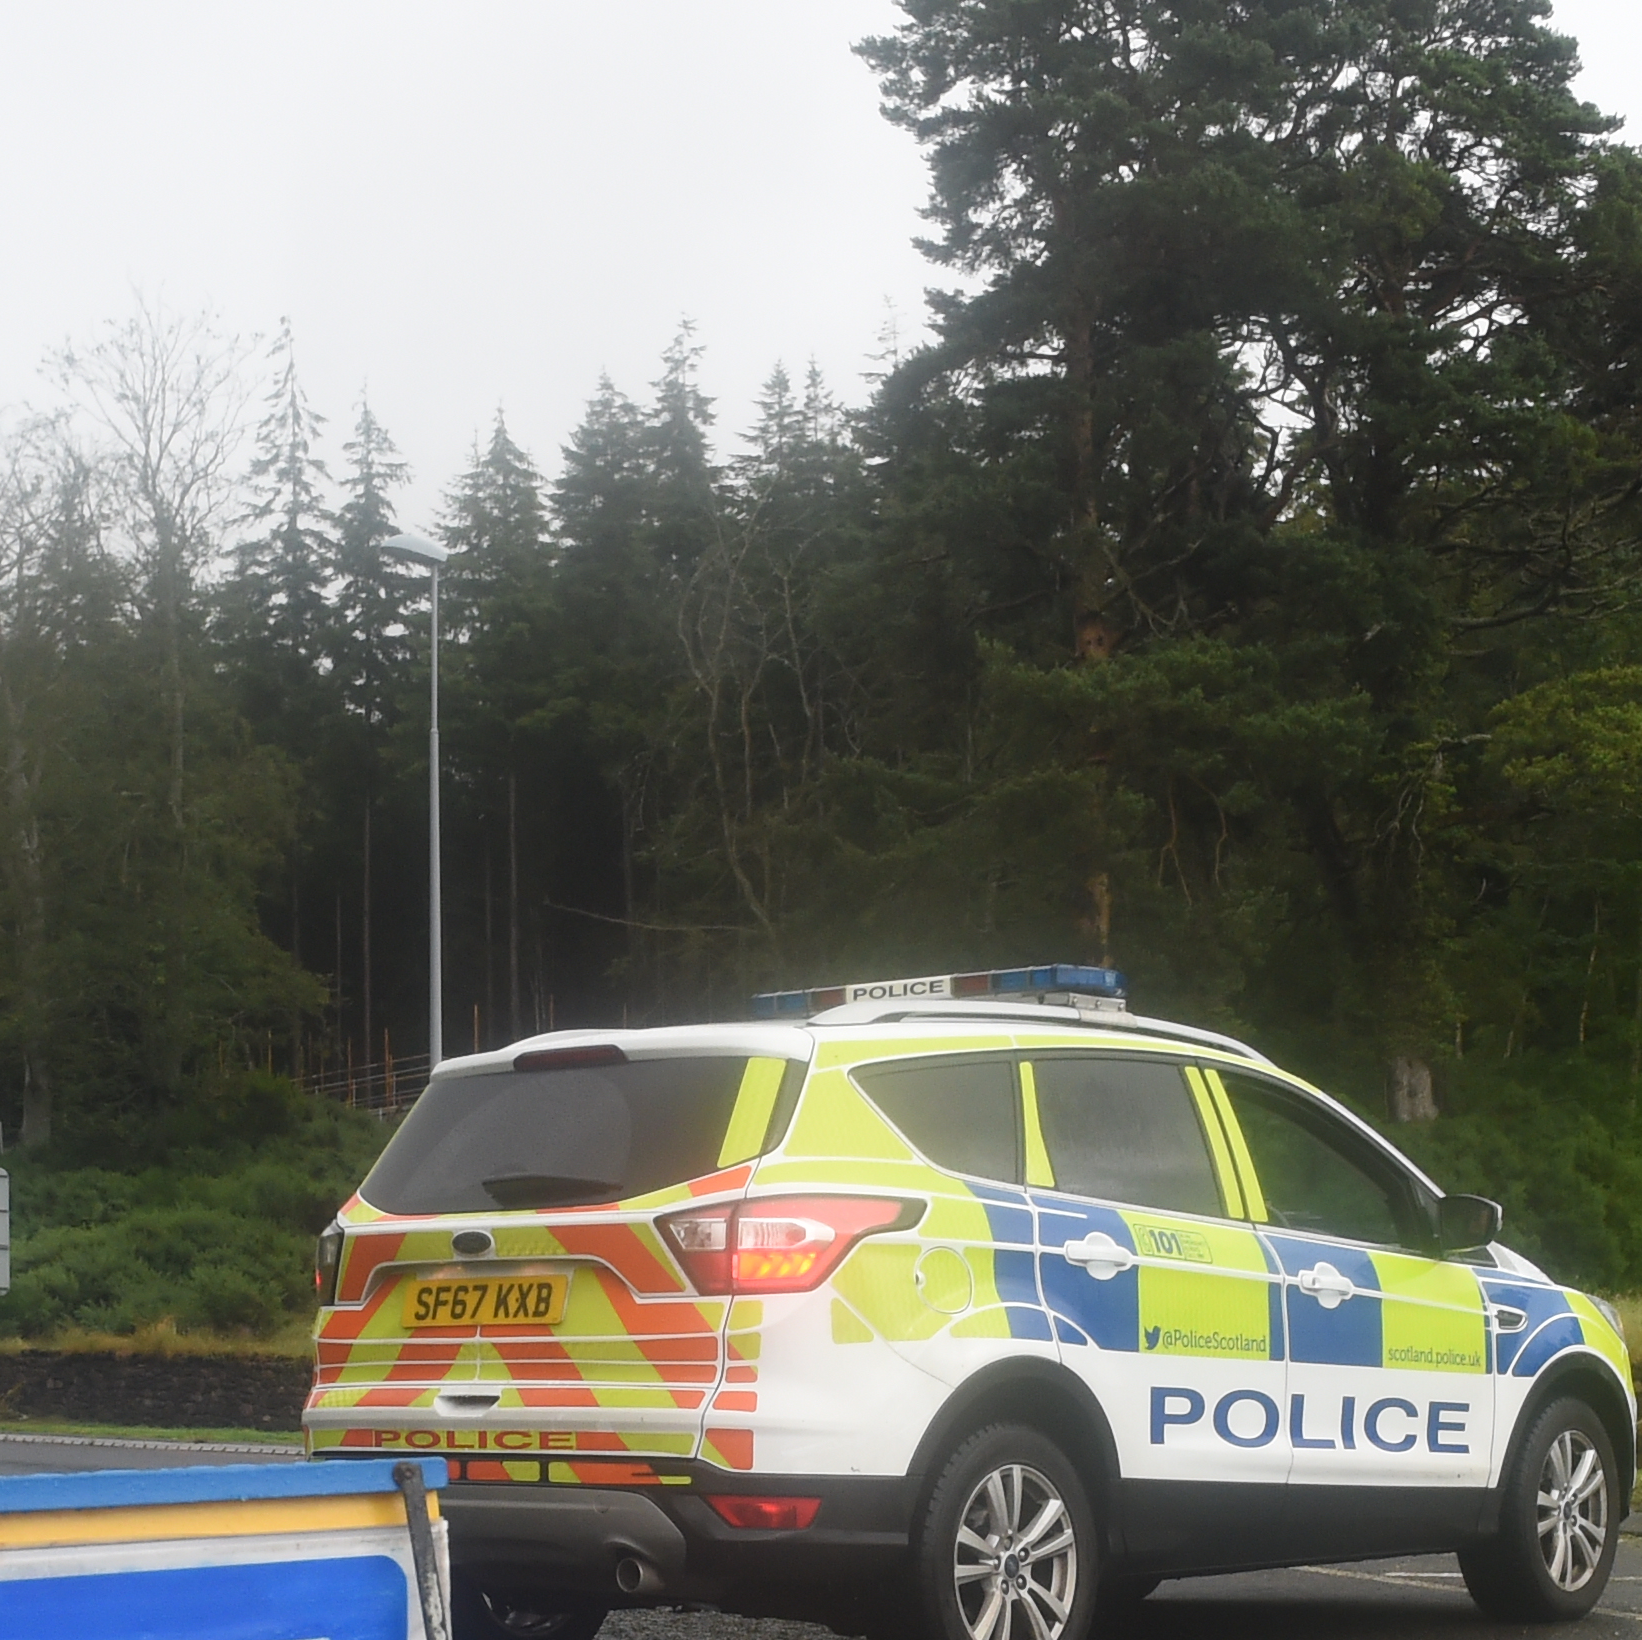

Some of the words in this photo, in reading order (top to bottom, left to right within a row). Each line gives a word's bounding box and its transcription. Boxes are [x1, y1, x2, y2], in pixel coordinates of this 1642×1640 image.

[852, 979, 945, 1000] POLICE
[1148, 1229, 1183, 1256] 101
[414, 1284, 489, 1321] SF67
[493, 1282, 554, 1318] KXB
[1162, 1329, 1266, 1353] @PoliceScotland
[1388, 1346, 1481, 1367] scotland.police.uk
[1149, 1386, 1471, 1455] POLICE
[373, 1430, 575, 1450] POLICE
